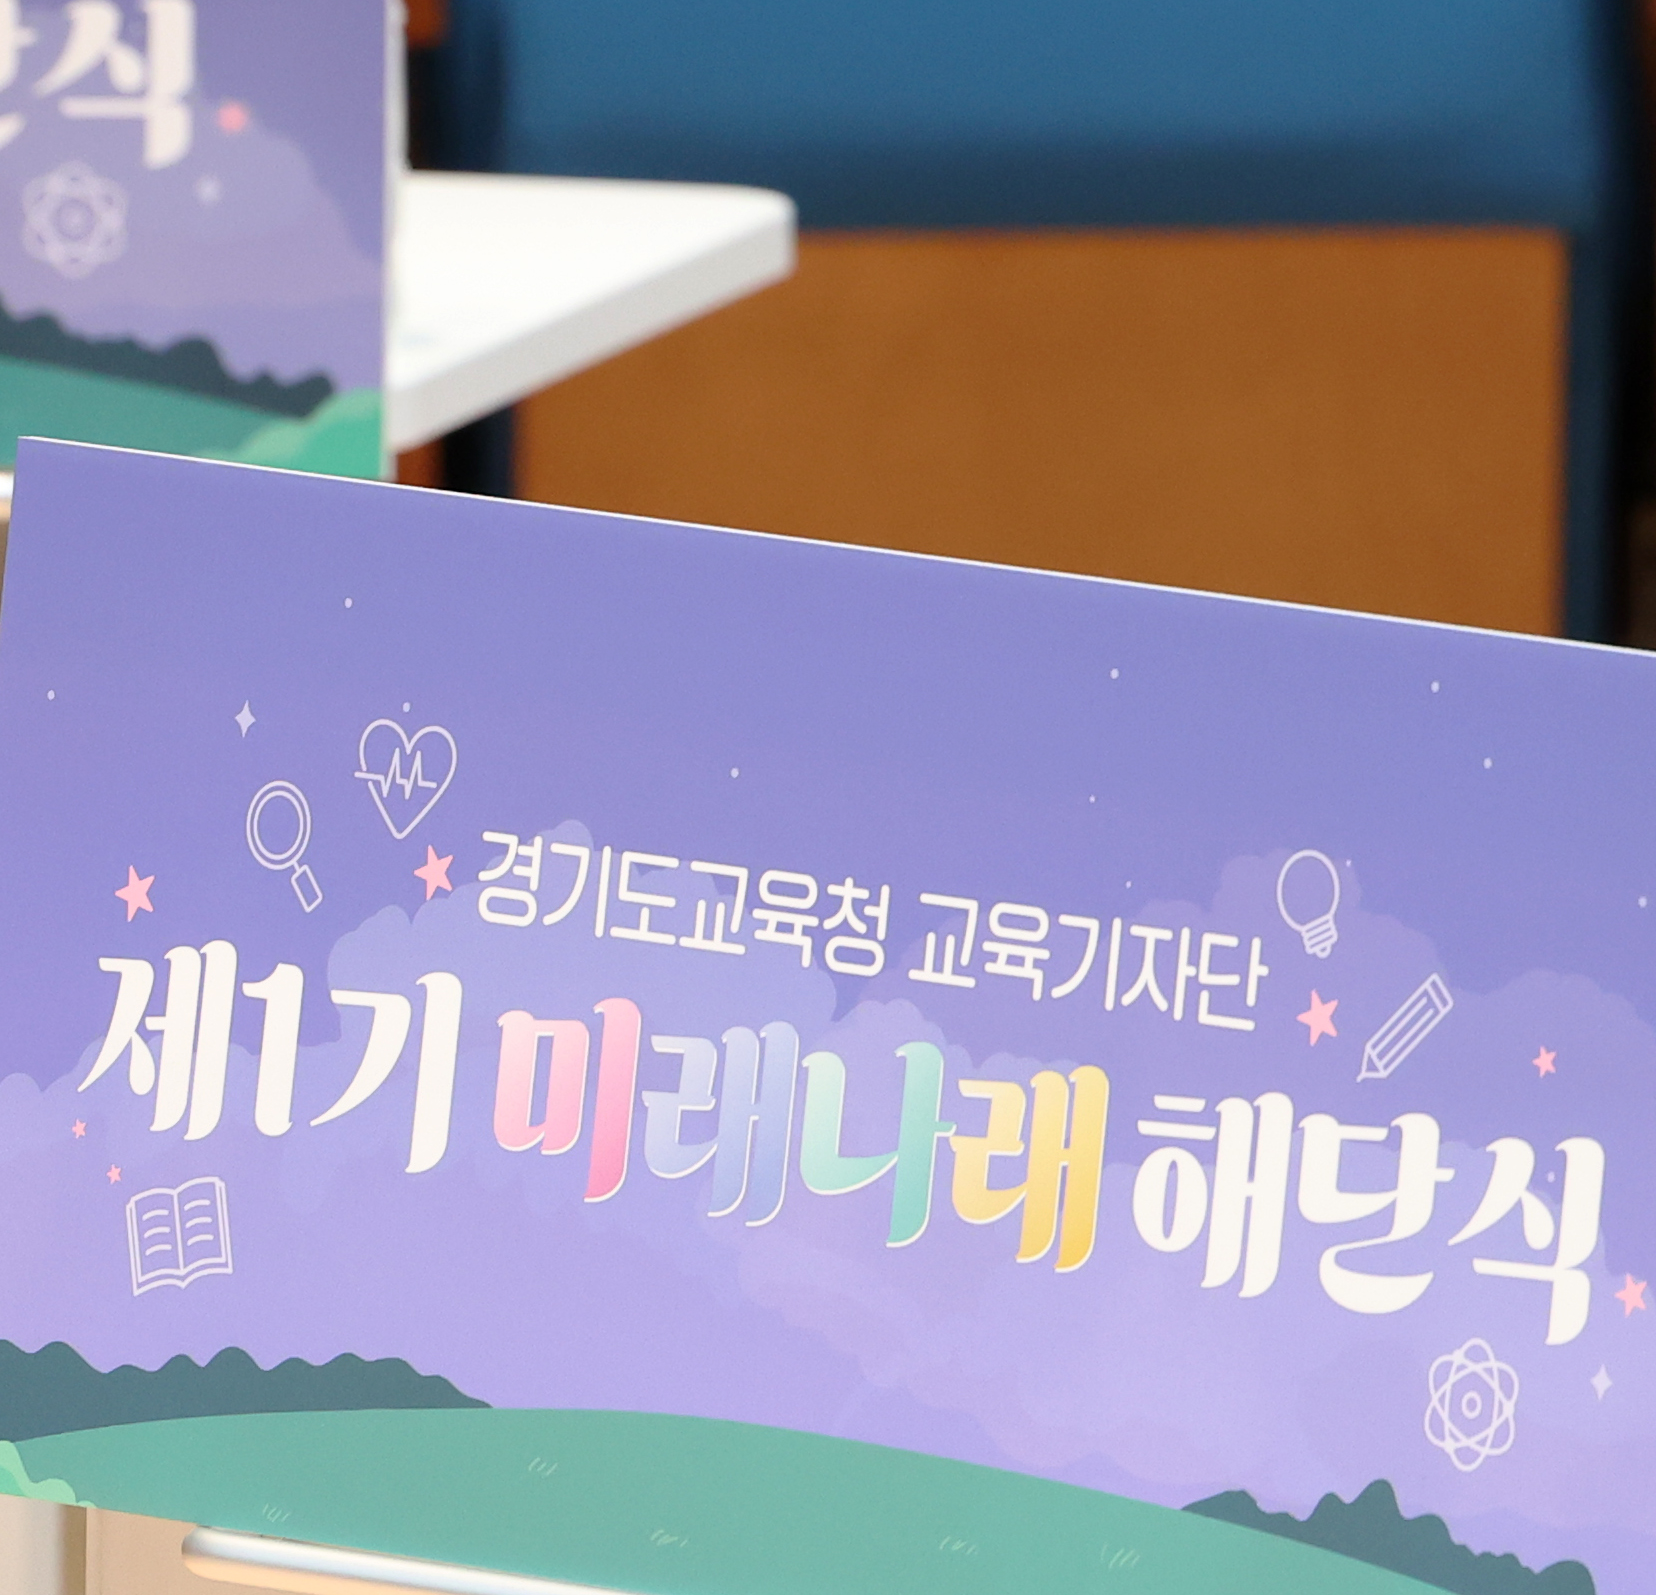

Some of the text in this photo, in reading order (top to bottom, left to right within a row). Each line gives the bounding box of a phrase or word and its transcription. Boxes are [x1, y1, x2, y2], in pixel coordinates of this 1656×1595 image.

[477, 830, 1269, 1032] 경기도교육청 교육기자단
[77, 940, 1606, 1345] 제1기 미래나래 해단식
